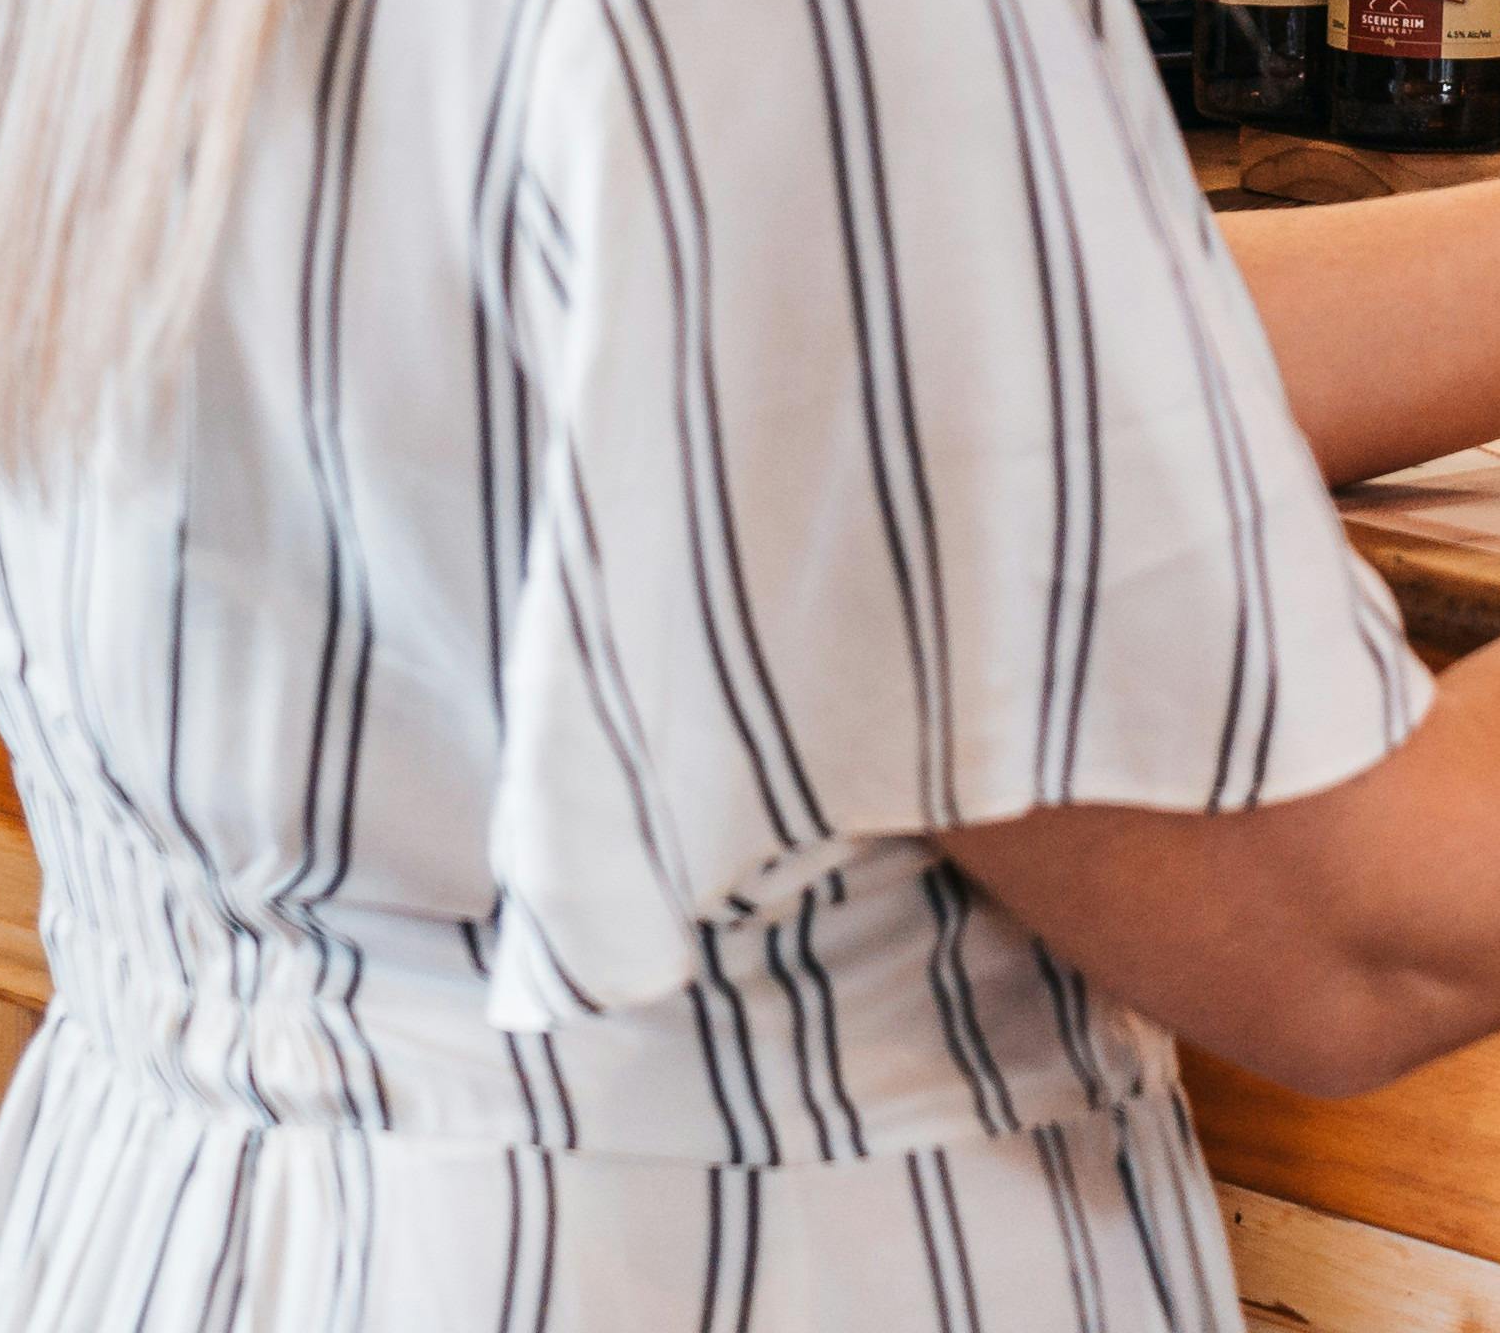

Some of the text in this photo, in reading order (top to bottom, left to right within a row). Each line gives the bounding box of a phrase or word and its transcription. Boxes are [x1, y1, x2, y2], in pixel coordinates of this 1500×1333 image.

[1361, 13, 1399, 27] SCENIC
[1402, 17, 1425, 29] RIM
[1370, 25, 1413, 36] BREWERY
